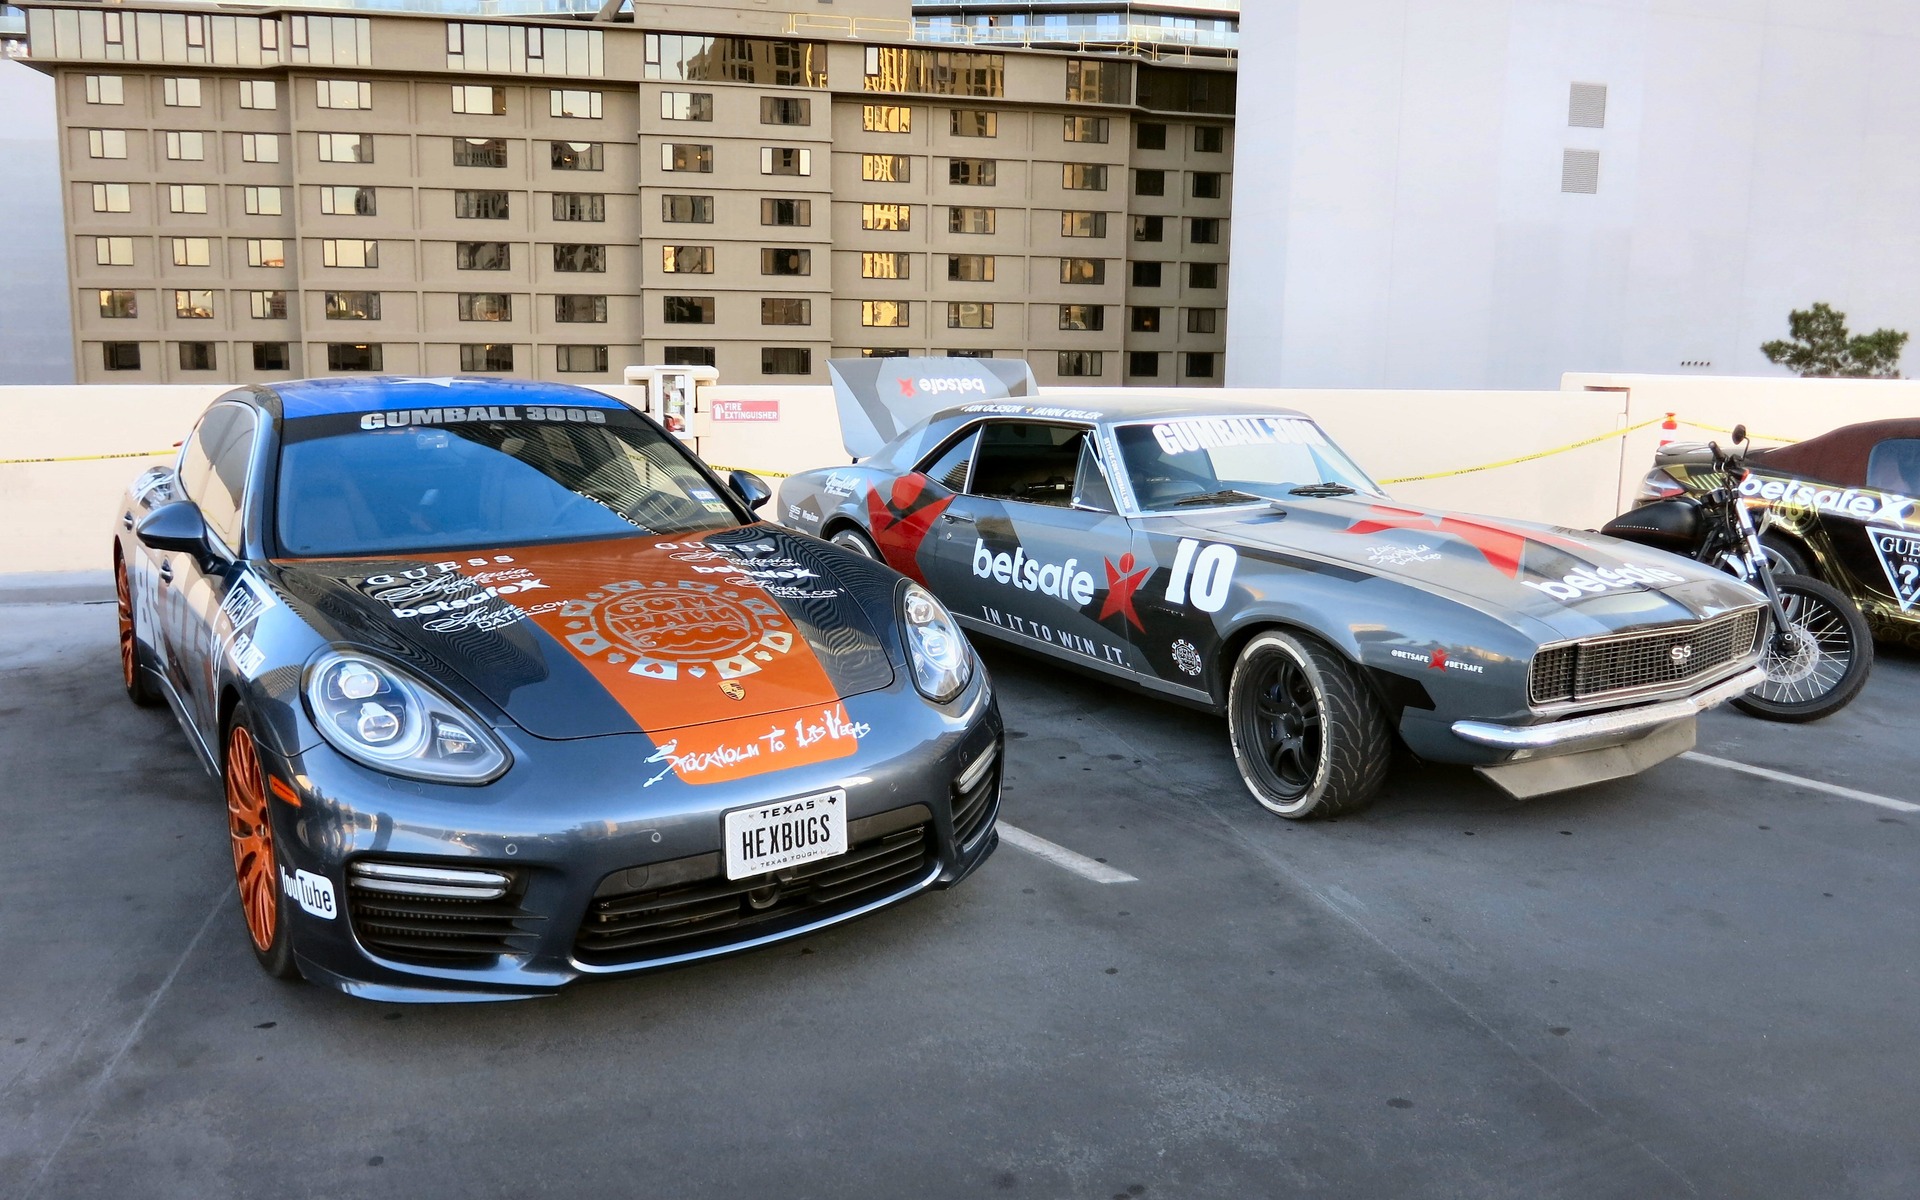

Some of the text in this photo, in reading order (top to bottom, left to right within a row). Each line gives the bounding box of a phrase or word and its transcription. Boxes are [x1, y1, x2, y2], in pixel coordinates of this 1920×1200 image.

[918, 377, 986, 394] betsafe
[360, 406, 606, 430] GUMBALL 3000
[724, 402, 742, 411] FIRE
[724, 411, 778, 420] EXTINGUISHER
[1152, 418, 1274, 456] GUMBALL
[1738, 473, 1875, 517] betsafe
[654, 541, 776, 552] GUESS
[1880, 536, 1920, 557] GUE
[366, 555, 515, 585] GUESS
[972, 537, 1094, 605] betsafe
[1165, 537, 1237, 612] 10
[223, 586, 262, 628] GUESS
[391, 585, 519, 618] betsafe
[981, 605, 1132, 668] IN IT TO WIN IT.
[1390, 649, 1484, 674] @BETSAFE #BETSAFE
[1671, 645, 1691, 660] SS
[760, 800, 816, 819] TEXAS
[742, 814, 832, 861] HEXBUGS
[760, 857, 788, 868] TEXAS
[790, 850, 818, 860] TOUGH
[279, 863, 332, 913] YouTube
